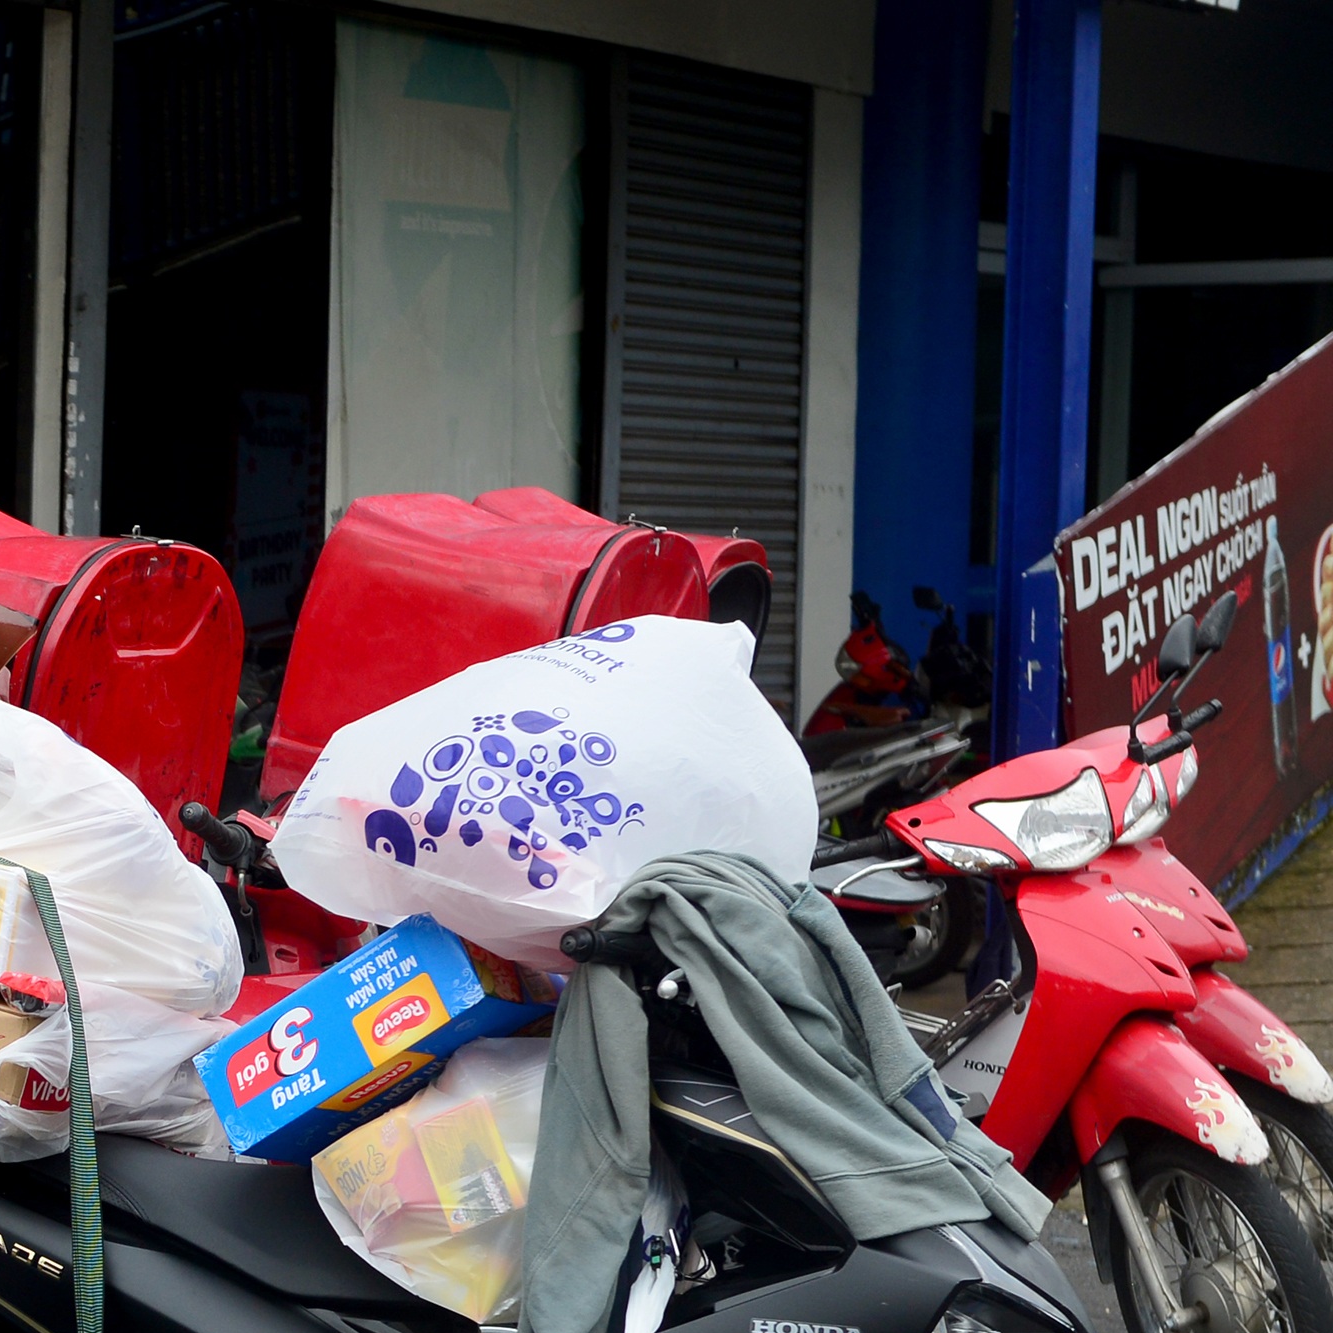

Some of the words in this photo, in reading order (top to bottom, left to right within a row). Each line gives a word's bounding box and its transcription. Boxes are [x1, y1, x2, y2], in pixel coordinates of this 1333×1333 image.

[1072, 514, 1156, 611] DEAL
[1156, 486, 1219, 565] NGON
[1219, 472, 1251, 529] SUỐT
[1101, 584, 1158, 675] ĐẶT
[1162, 550, 1214, 627] NGAY
[401, 955, 418, 975] MÌ
[374, 999, 426, 1039] Reeva
[268, 1006, 319, 1077] 3
[32, 1079, 71, 1102] VIFO
[235, 1051, 270, 1091] gói
[271, 1068, 327, 1111] Tặng
[350, 1063, 409, 1099] Reeva
[336, 1161, 369, 1198] BON!
